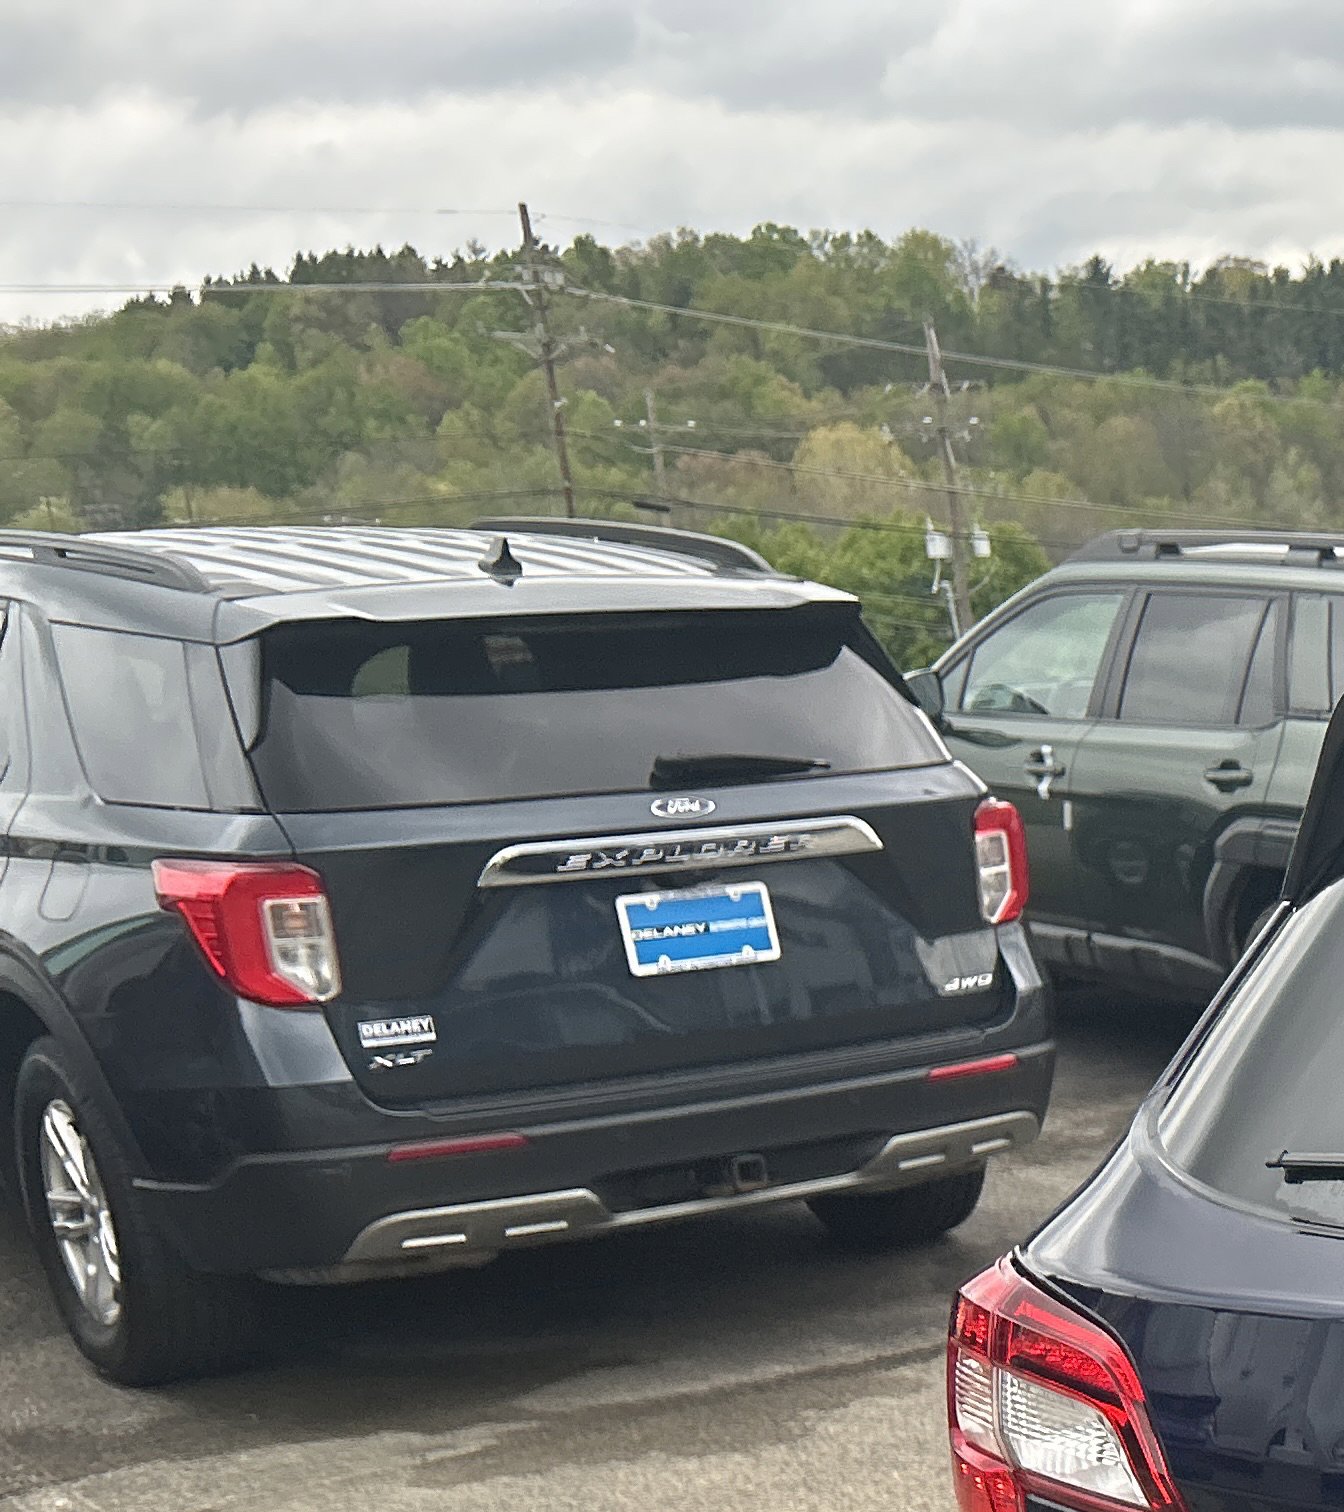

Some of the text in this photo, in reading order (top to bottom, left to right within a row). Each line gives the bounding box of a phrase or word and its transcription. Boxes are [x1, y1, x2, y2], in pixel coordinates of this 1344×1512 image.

[556, 834, 813, 872] EXPLORER
[632, 921, 706, 942] DELANEY
[361, 1017, 431, 1038] DELANEY
[369, 1048, 433, 1071] XLT
